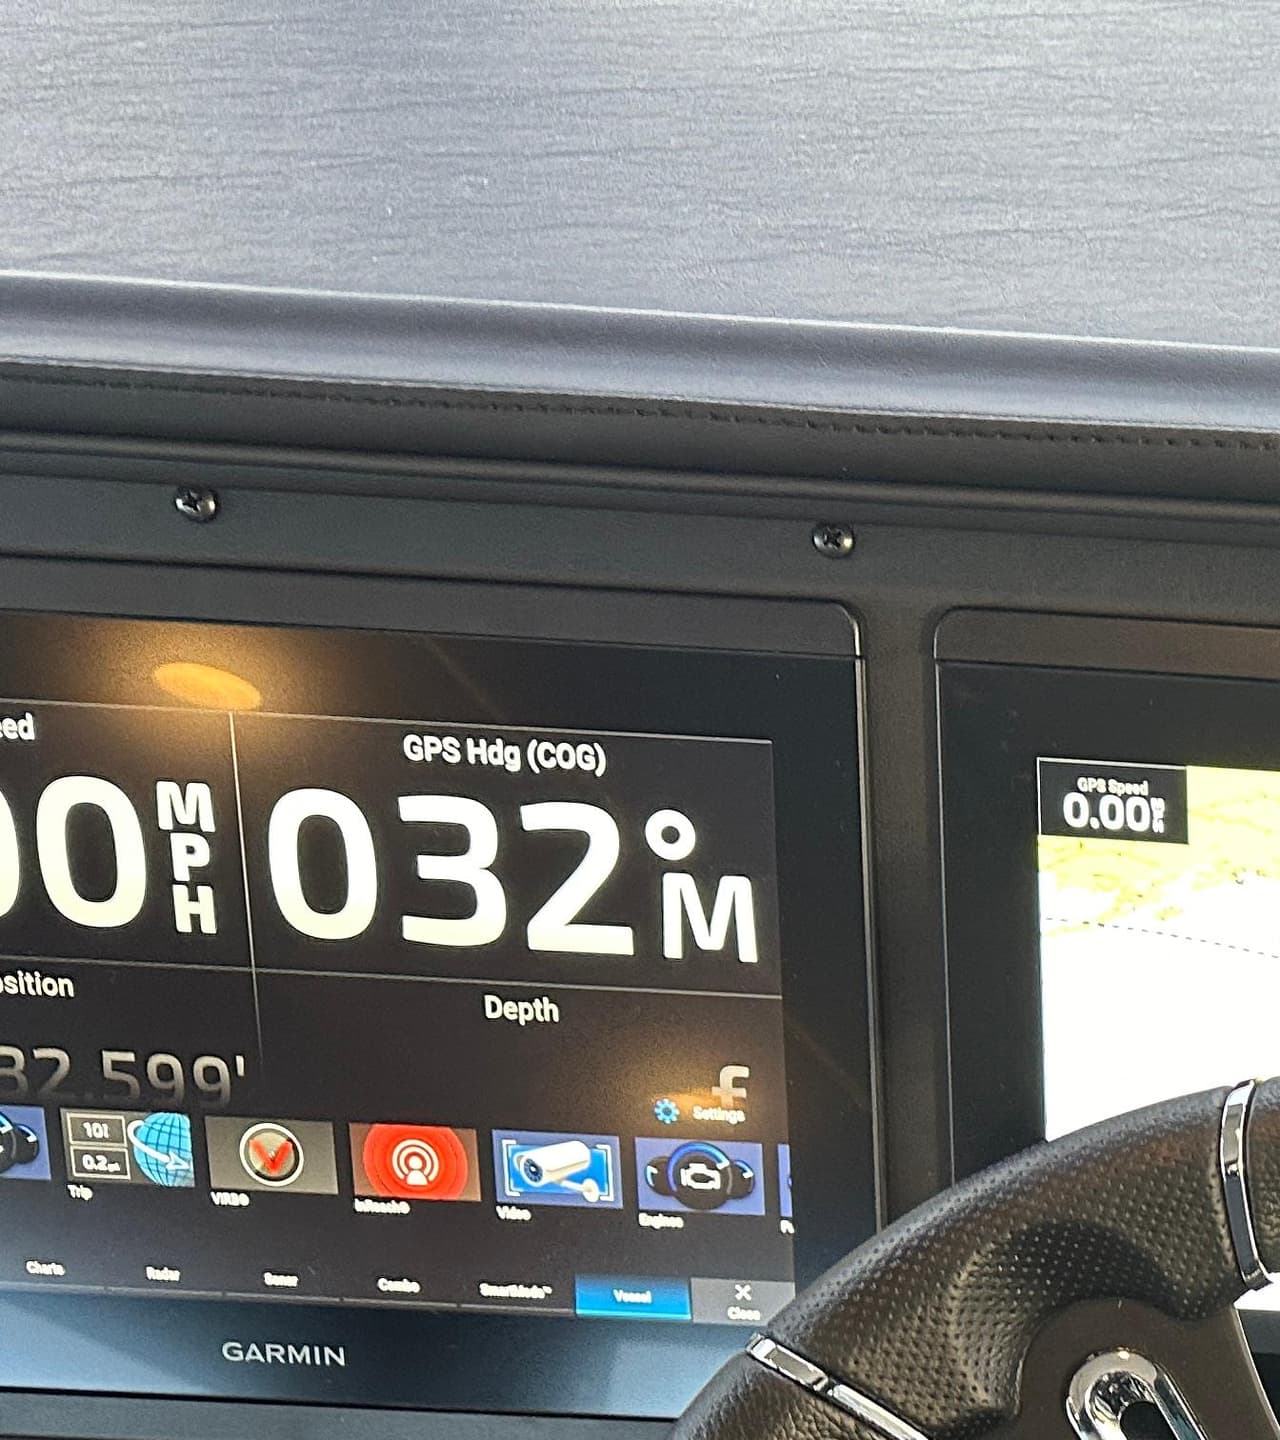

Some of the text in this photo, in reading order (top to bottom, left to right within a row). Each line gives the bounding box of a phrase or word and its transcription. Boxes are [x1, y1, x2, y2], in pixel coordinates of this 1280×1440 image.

[0, 712, 36, 741] ed
[403, 733, 607, 777] GPS Hdg (COG)
[1077, 776, 1148, 797] GPS Speed
[1063, 792, 1151, 832] 0.00
[0, 775, 147, 929] 0
[0, 970, 75, 998] sition
[484, 994, 560, 1026] Depth
[692, 1105, 746, 1125] Settings
[222, 1341, 346, 1367] GARMIN
